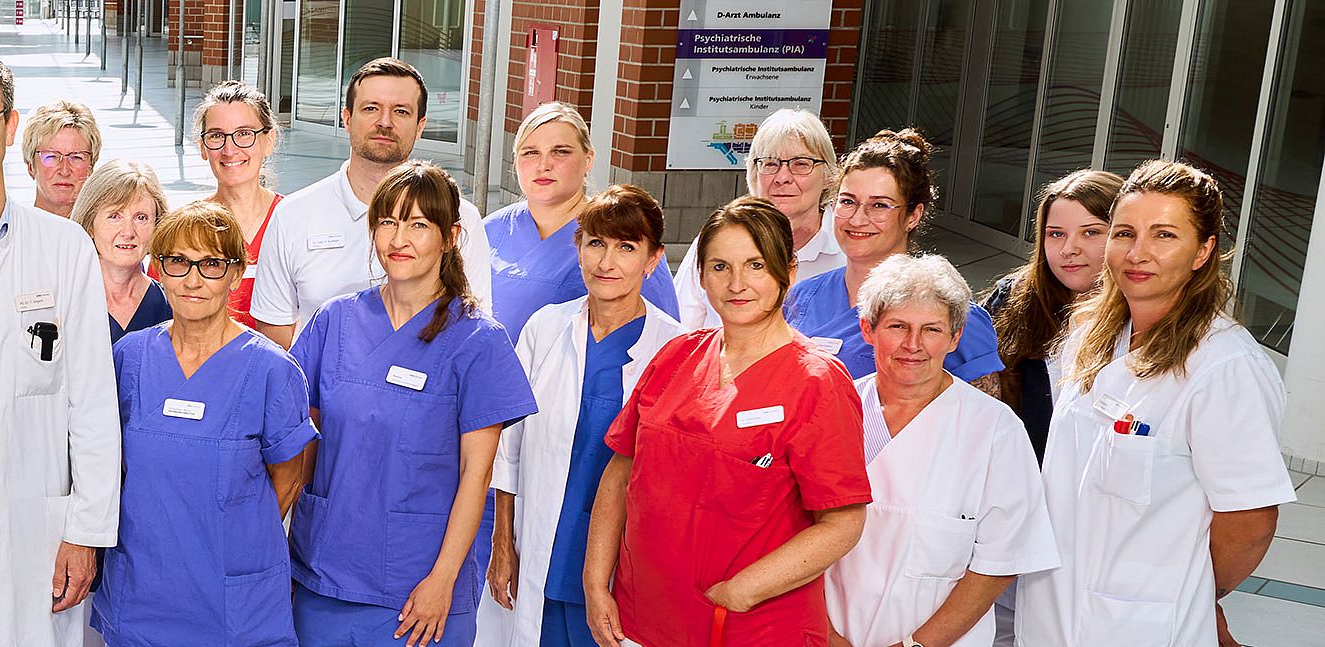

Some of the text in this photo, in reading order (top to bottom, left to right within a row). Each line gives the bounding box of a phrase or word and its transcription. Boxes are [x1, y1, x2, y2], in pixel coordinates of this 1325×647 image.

[717, 11, 781, 19] D-Arzt Ambulanz
[694, 34, 762, 44] Psychiatrische
[693, 45, 805, 55] Institutsambulanz (PIA)
